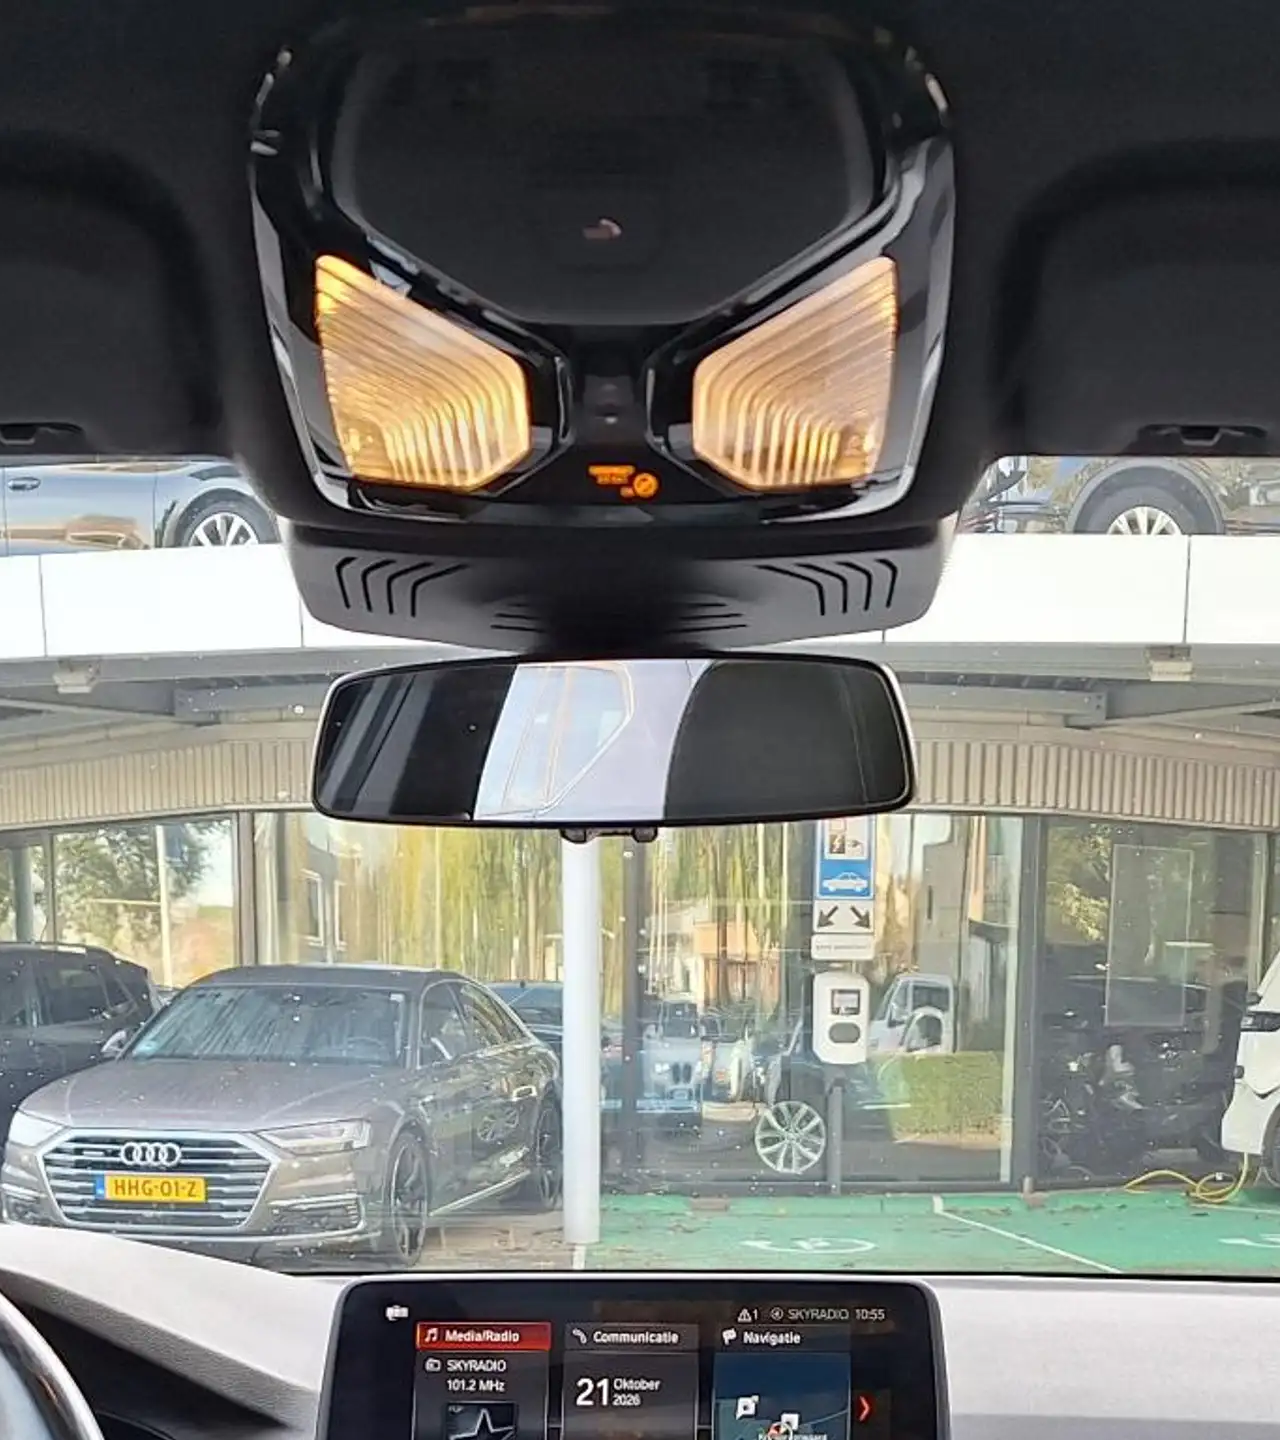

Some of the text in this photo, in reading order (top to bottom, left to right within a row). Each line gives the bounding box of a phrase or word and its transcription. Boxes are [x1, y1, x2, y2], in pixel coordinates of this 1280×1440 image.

[114, 1179, 197, 1198] HHG-01-Z
[787, 1308, 849, 1320] SKYRADIO
[855, 1308, 886, 1320] 10:55
[444, 1329, 520, 1343] Media/Radio
[593, 1331, 679, 1344] Communicatie
[743, 1331, 801, 1346] Navigatie
[447, 1359, 507, 1372] SKYRADIO
[447, 1379, 506, 1392] 101.2 MHz
[576, 1378, 661, 1406] 21 Oktober
